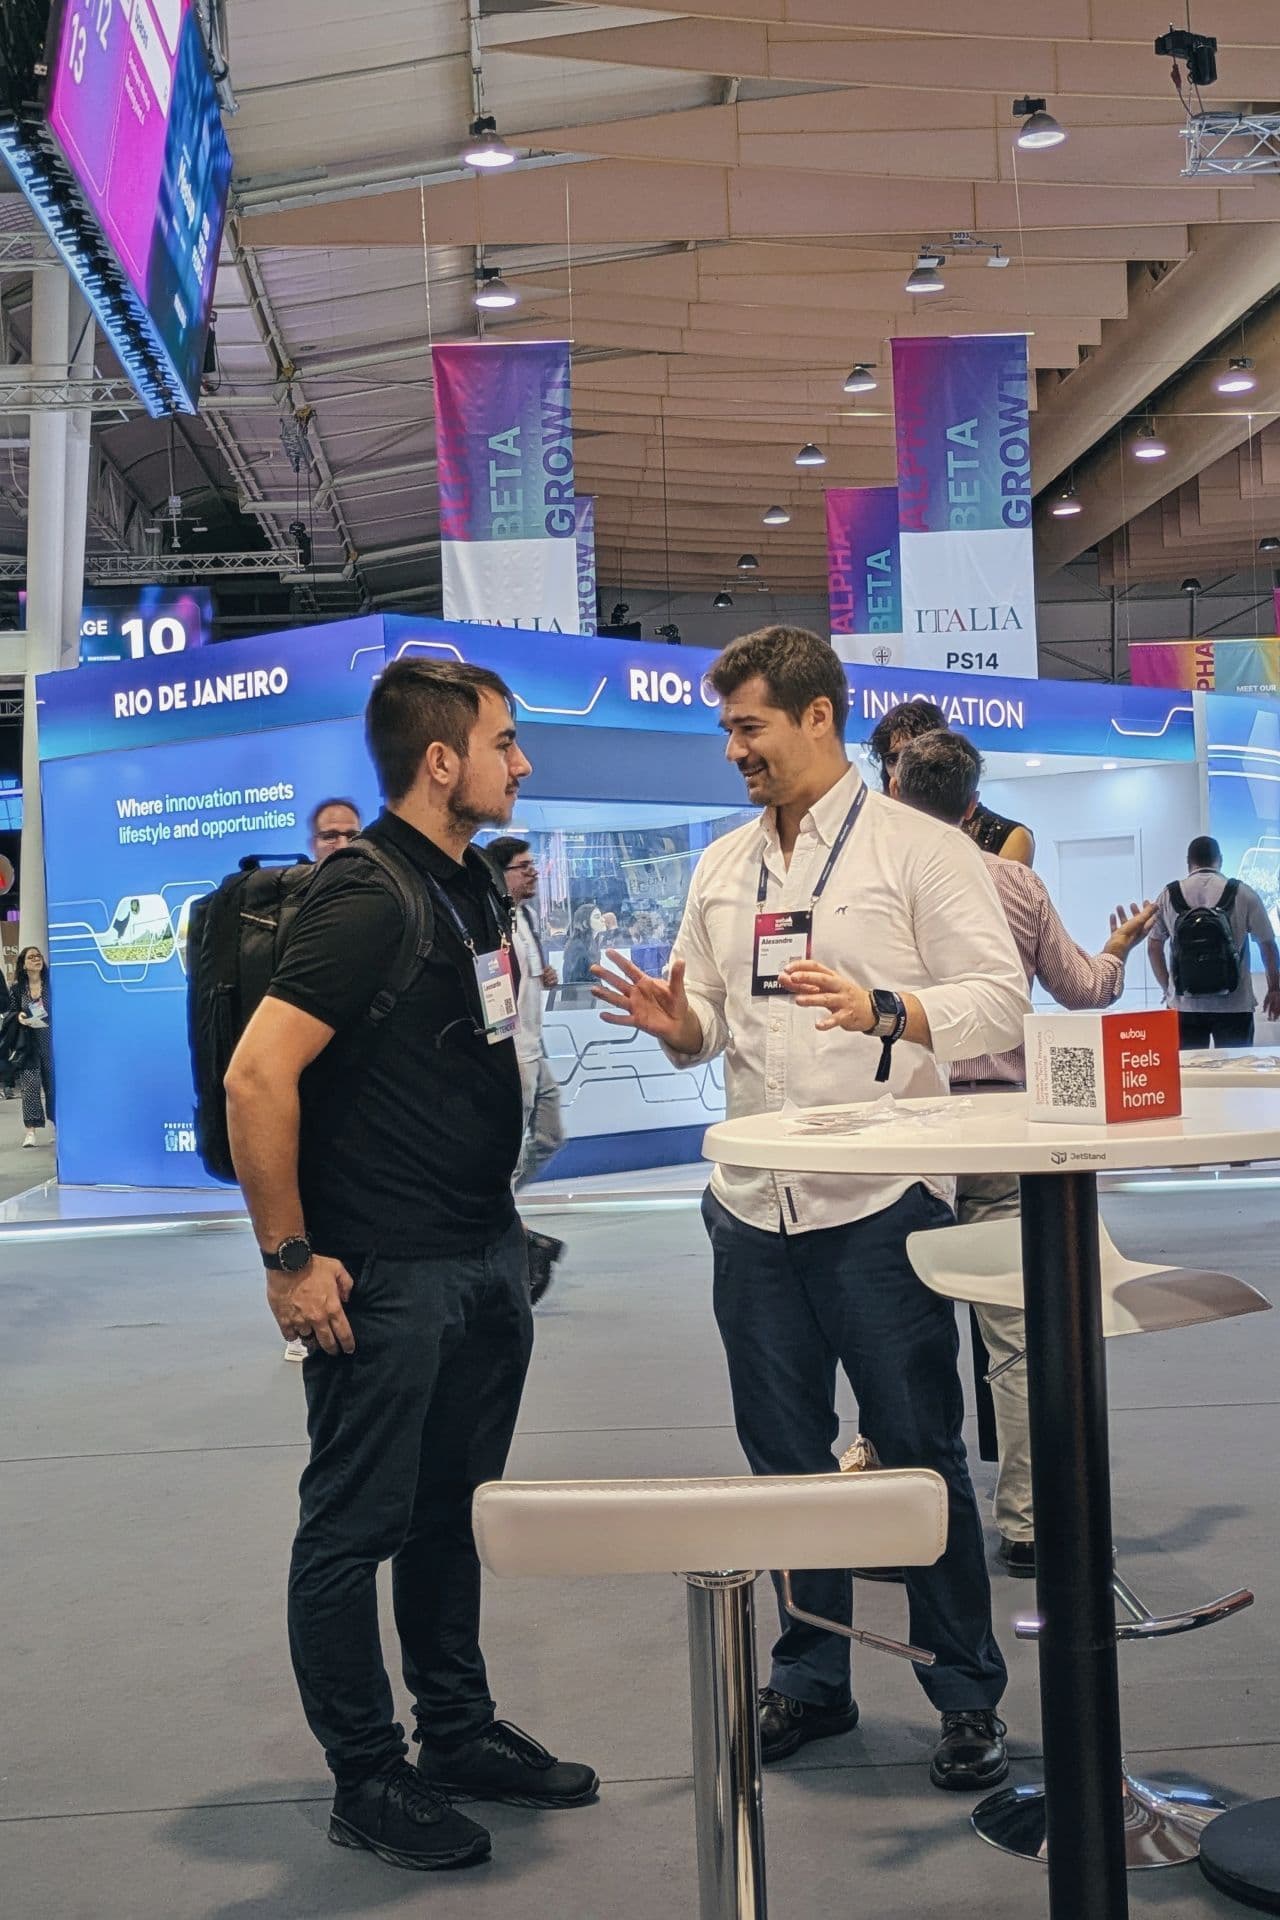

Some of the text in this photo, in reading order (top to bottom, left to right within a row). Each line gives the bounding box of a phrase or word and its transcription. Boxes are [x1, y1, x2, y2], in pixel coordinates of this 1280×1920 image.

[69, 12, 87, 85] 13
[488, 426, 524, 538] BETA
[946, 418, 981, 530] BETA
[828, 526, 854, 634] ALPHA
[866, 549, 893, 633] BETA
[121, 617, 186, 659] 10
[915, 605, 1023, 634] ITALIA
[946, 652, 999, 670] PS14
[1195, 642, 1216, 692] PHA
[114, 666, 288, 718] RIO DE JANEIRO
[629, 668, 692, 705] RIO:
[1236, 683, 1277, 692] MEET OUR
[116, 782, 294, 818] Where innovation meets
[119, 810, 295, 846] lifestyle and opportunities
[1121, 1049, 1161, 1069] Feels
[1122, 1071, 1147, 1088] like
[1123, 1091, 1165, 1108] home
